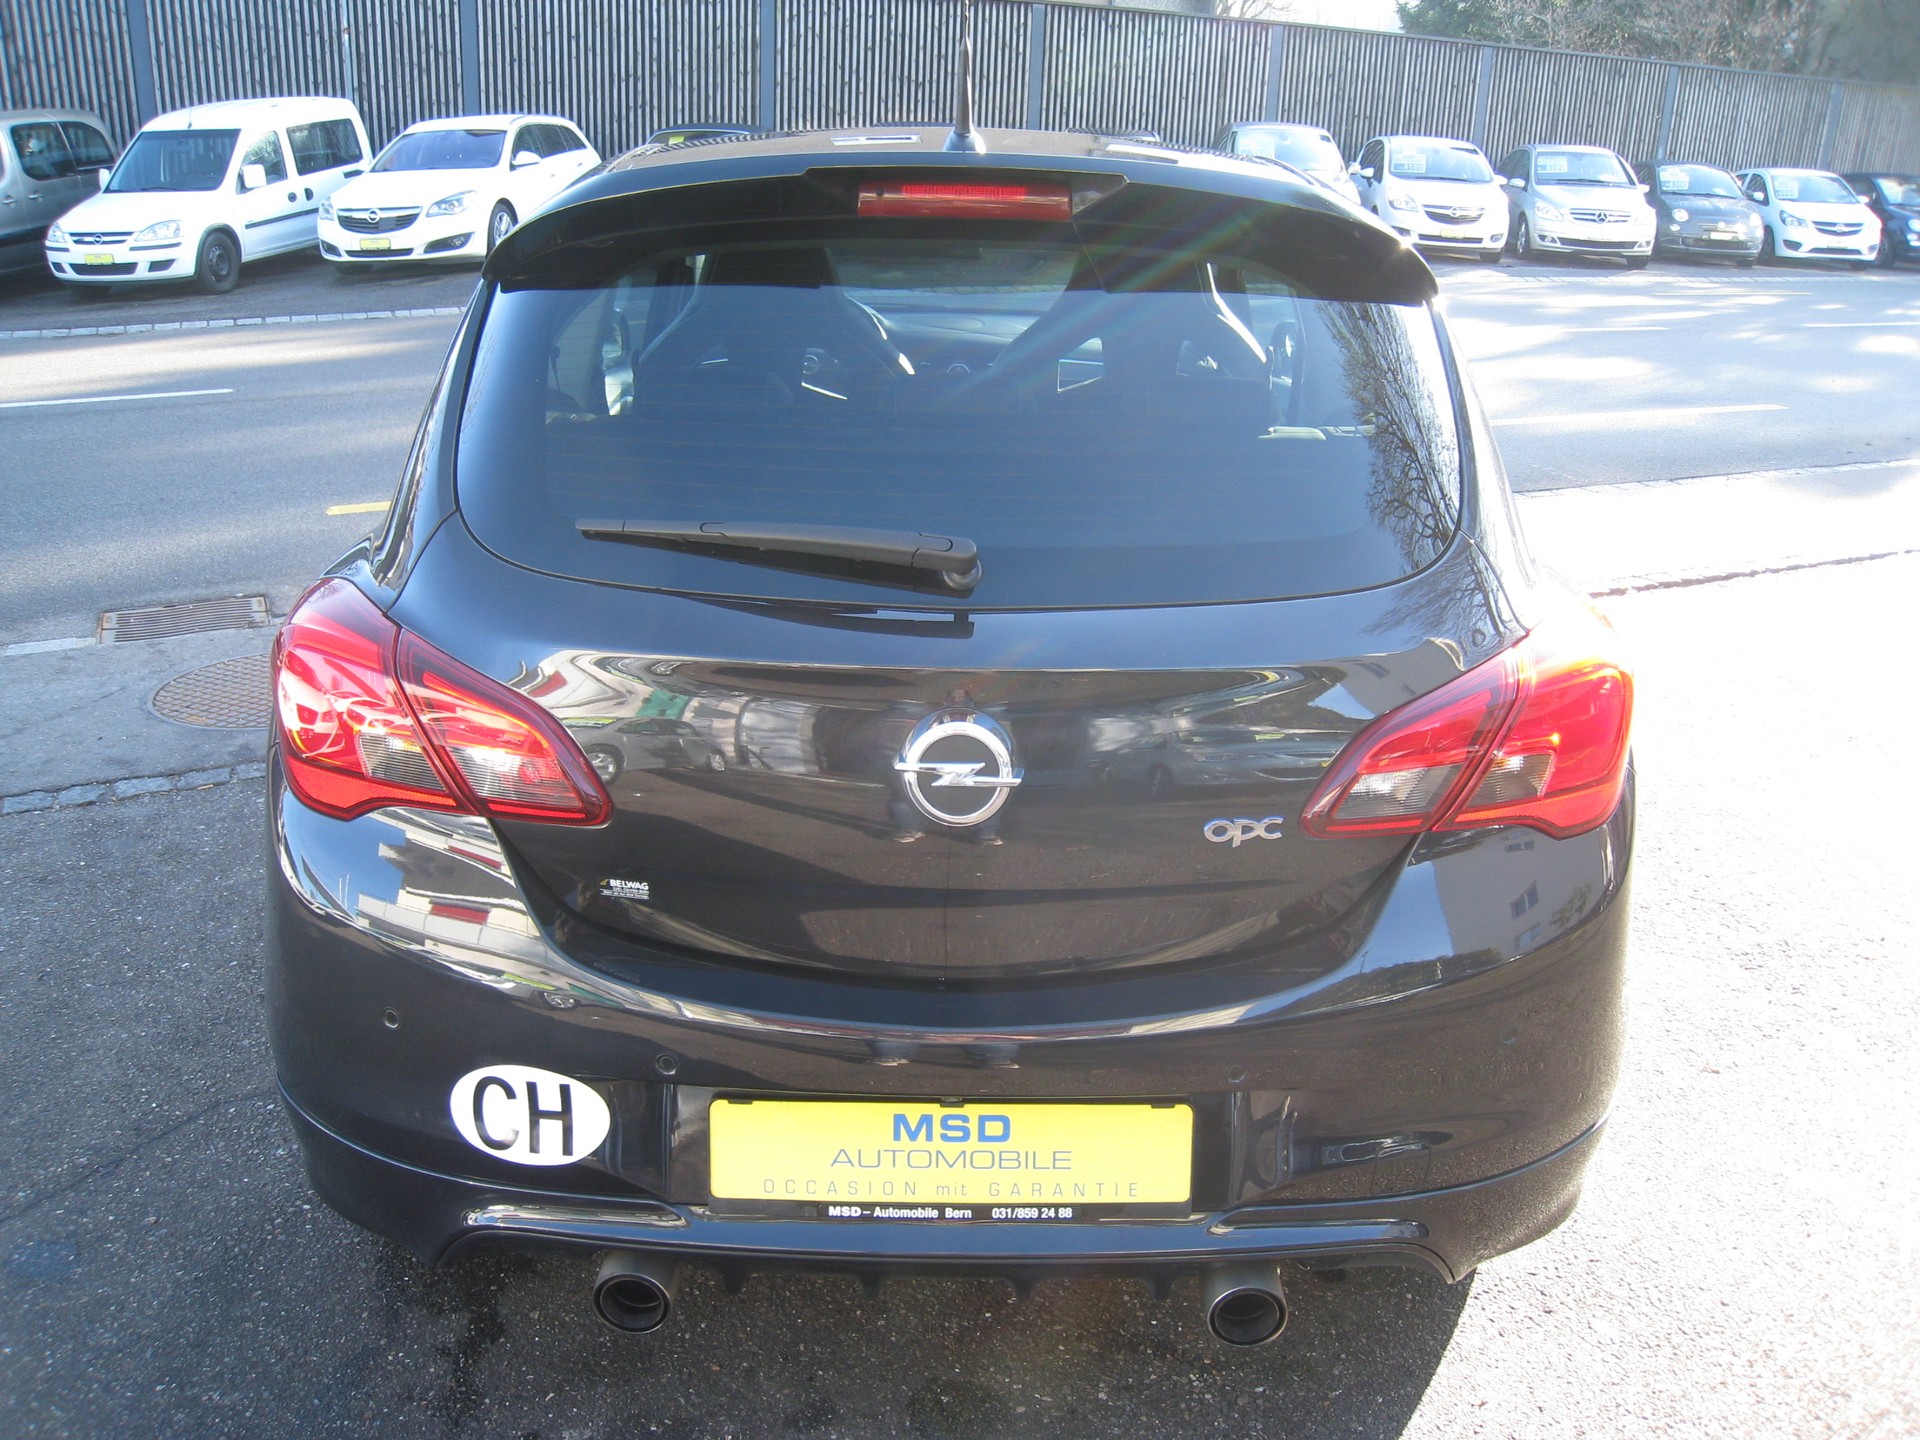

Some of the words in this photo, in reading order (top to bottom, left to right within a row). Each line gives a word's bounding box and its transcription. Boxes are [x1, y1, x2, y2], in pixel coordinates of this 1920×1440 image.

[609, 879, 649, 891] BELWAG
[473, 1075, 574, 1157] CH
[893, 1113, 1011, 1143] MSD
[830, 1148, 1073, 1170] AUTOMOBILE
[763, 1178, 917, 1196] OCCASION
[936, 1181, 968, 1197] mit
[988, 1182, 1139, 1198] GARANTIE
[945, 1207, 972, 1219] Bern
[991, 1207, 1039, 1219] 031/859
[1040, 1207, 1055, 1219] 24
[1058, 1207, 1073, 1219] 88
